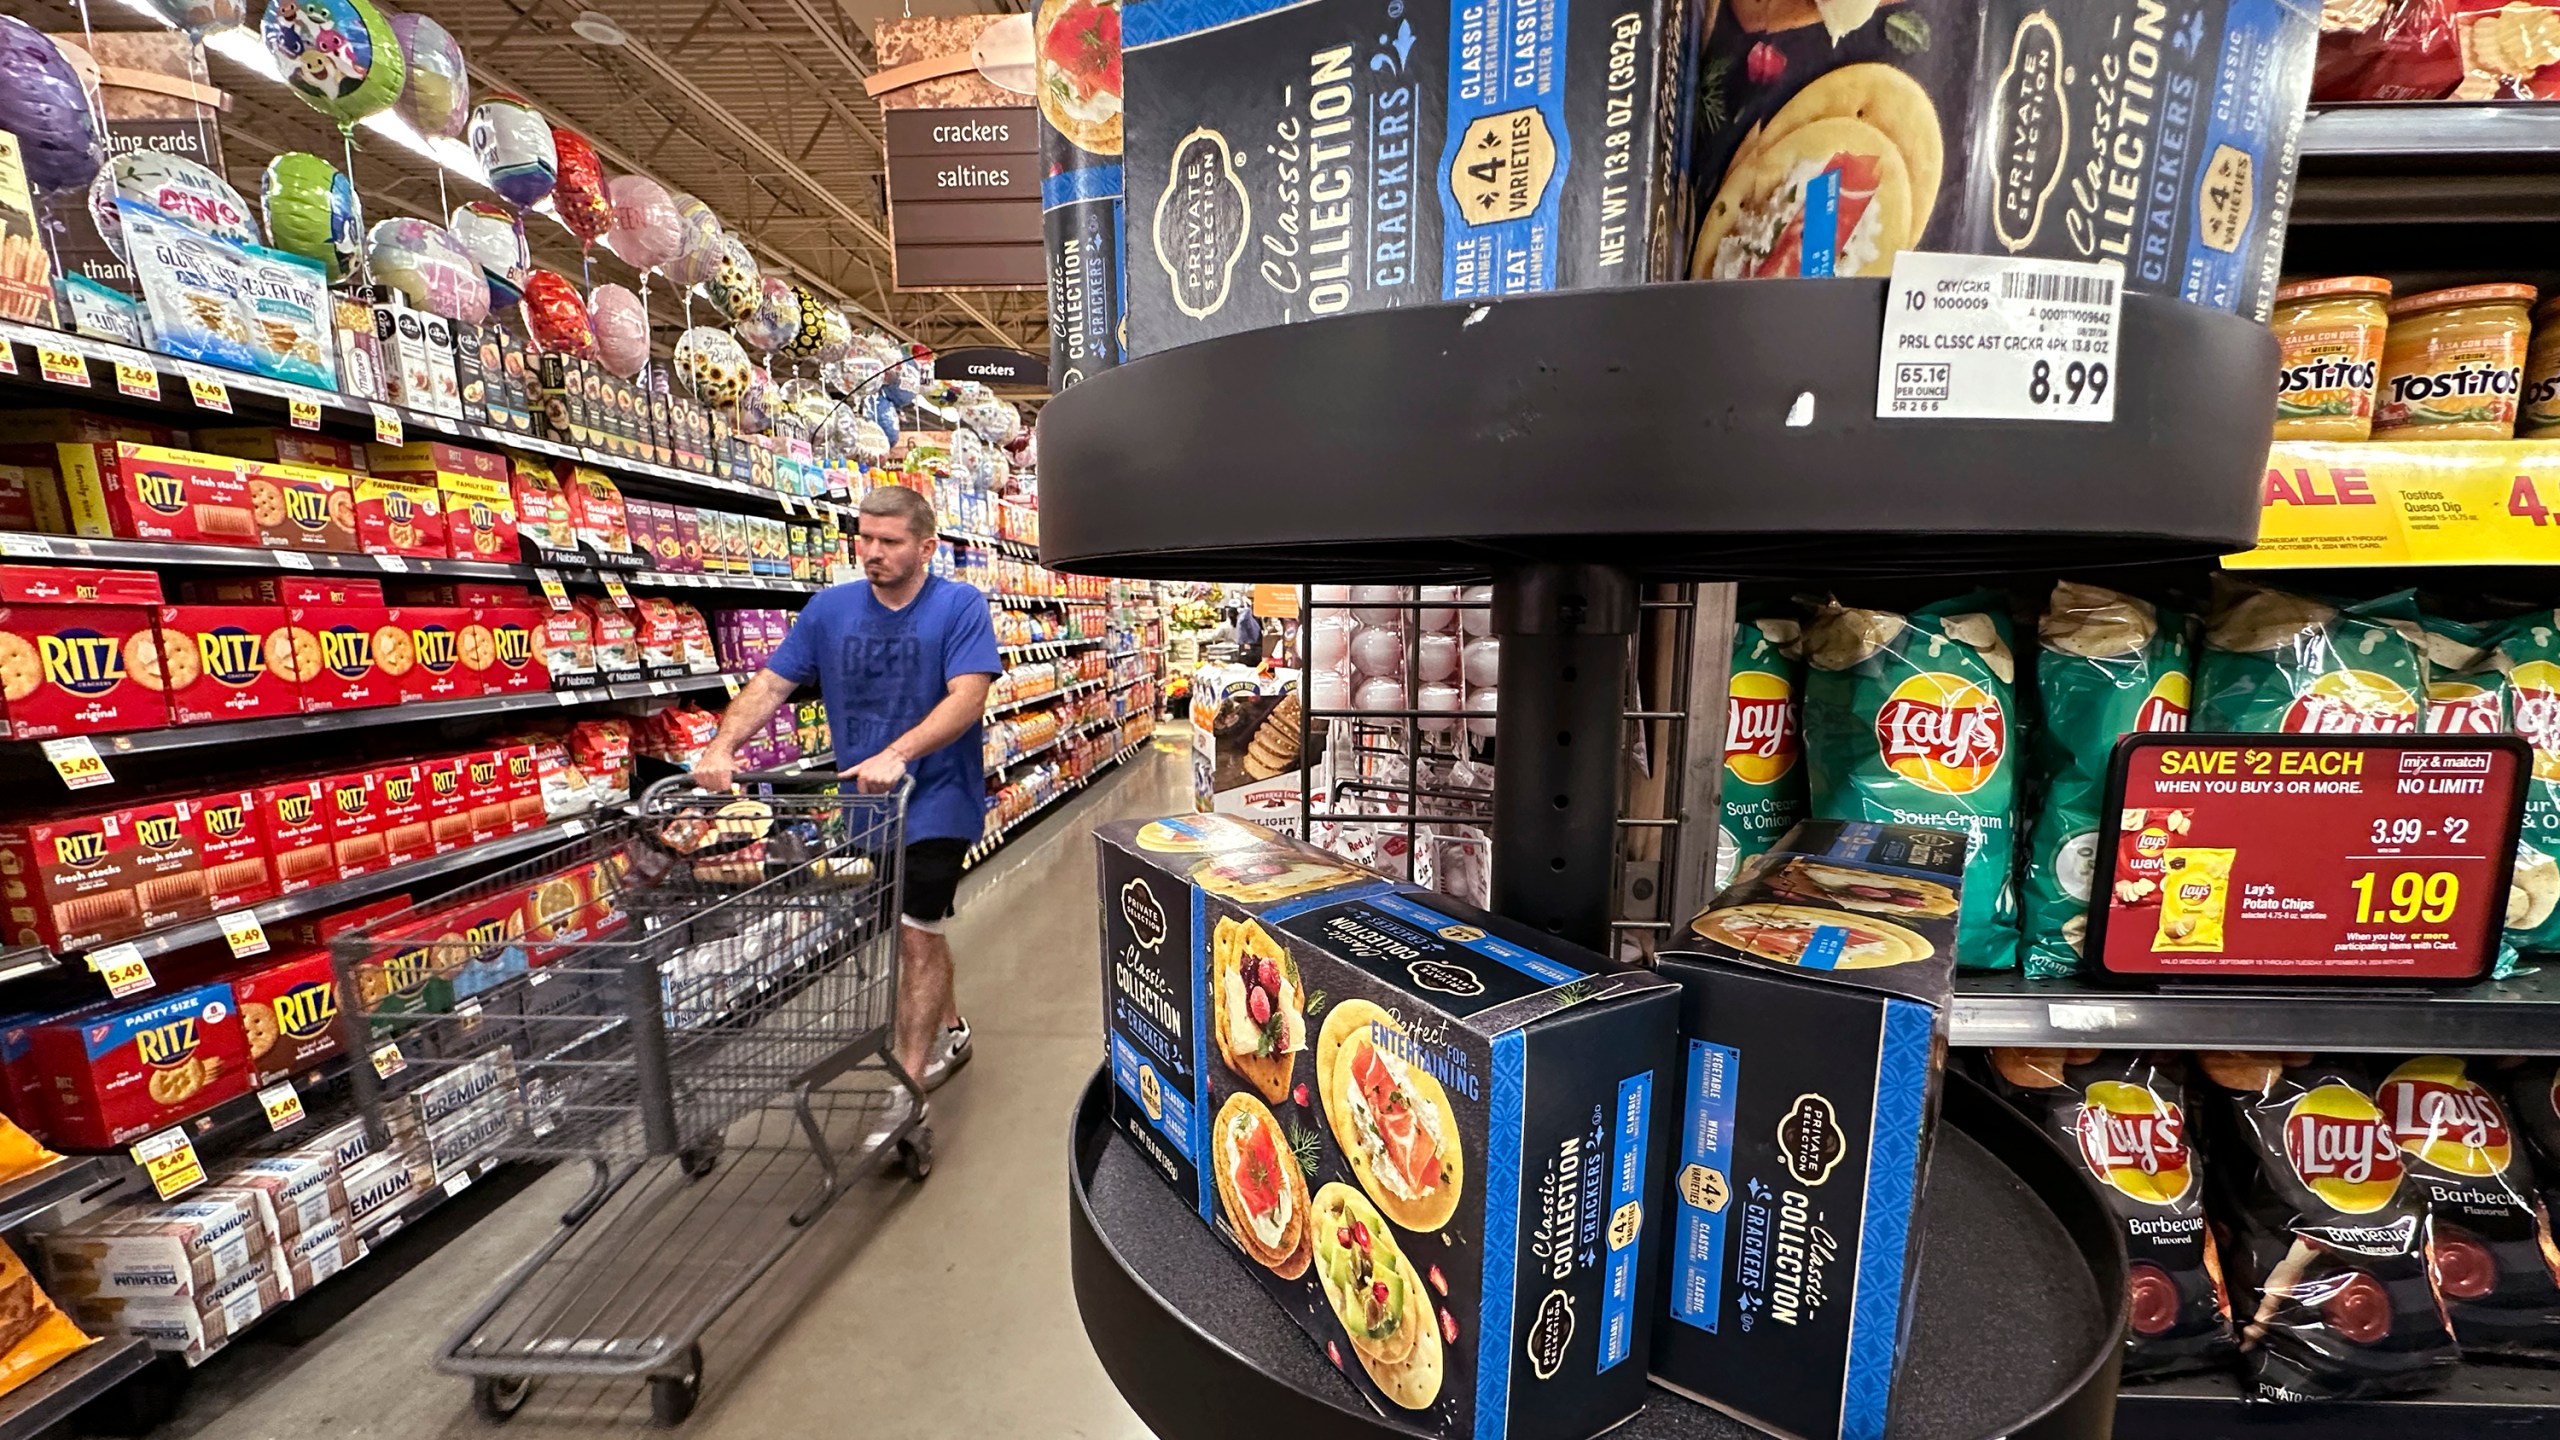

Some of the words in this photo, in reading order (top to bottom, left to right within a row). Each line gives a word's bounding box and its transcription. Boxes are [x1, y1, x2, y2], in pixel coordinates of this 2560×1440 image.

[1461, 6, 1482, 99] CLASSIC
[1608, 12, 1641, 91] (392g)
[1606, 94, 1632, 127] OZ
[933, 120, 1009, 143] crackers
[1510, 116, 1530, 212] VARIETIES
[1605, 133, 1630, 177] 13.8
[937, 165, 1010, 188] saltines
[1376, 87, 1409, 287] CRACKERS
[2142, 75, 2193, 280] CRACKERS
[1261, 117, 1301, 294] Classic
[1603, 186, 1628, 224] WT
[1188, 163, 1202, 289] PRIVATE
[1204, 153, 1215, 290] SELECTION
[1602, 228, 1624, 266] NET
[1064, 239, 1085, 360] COLLECTION
[1090, 258, 1105, 335] CRACKERS
[1905, 290, 1926, 311] 10
[1937, 280, 1990, 294] CKY/CRKR
[1053, 266, 1067, 338] Classic
[1933, 297, 1989, 310] 1000009
[1899, 334, 1931, 350] PRSL
[1934, 335, 1974, 350] CLSSC
[1977, 336, 2000, 350] AST
[2003, 336, 2043, 351] CRCKR
[2046, 338, 2068, 353] 4PK
[2093, 340, 2109, 354] OZ
[46, 352, 79, 368] 2.69
[967, 362, 1015, 377] crackers
[122, 366, 152, 383] 2.69
[194, 380, 223, 397] 4.49
[1900, 367, 1946, 383] 65.1¢
[2029, 359, 2109, 405] 8.99
[1897, 386, 1914, 396] PER
[1915, 386, 1947, 396] OUNCE
[294, 402, 318, 417] 4.49
[1910, 401, 1917, 411] 2
[1920, 401, 1928, 411] 6
[1931, 401, 1939, 411] 6
[191, 475, 216, 489] fresh
[217, 482, 245, 492] stacks
[455, 480, 476, 490] FAMILY
[476, 483, 495, 492] SIZE
[2399, 490, 2444, 500] Tostitos
[2404, 502, 2440, 513] Queso
[2443, 502, 2462, 513] Dip
[556, 552, 587, 565] Nabisco
[619, 555, 644, 567] Nabisco
[197, 633, 267, 675] RITZ
[319, 631, 374, 669] RITZ
[412, 629, 458, 665] RITZ
[493, 628, 532, 660] RITZ
[37, 635, 127, 684] RITZ
[660, 667, 684, 678] Nabisco
[567, 674, 596, 686] Nabisco
[615, 671, 641, 683] Nabisco
[75, 706, 117, 722] original
[225, 696, 259, 710] original
[60, 757, 99, 775] 5.49
[2160, 751, 2239, 775] SAVE
[2244, 749, 2272, 775] $2
[2279, 751, 2364, 775] EACH
[2404, 756, 2429, 772] mix
[2430, 756, 2441, 768] &
[2443, 756, 2485, 768] match
[385, 778, 416, 801] RITZ
[2155, 780, 2201, 793] WHEN
[2204, 781, 2237, 793] YOU
[2240, 781, 2273, 793] BUY
[2274, 781, 2284, 793] 3
[2287, 781, 2310, 793] OR
[2313, 781, 2363, 793] MORE.
[2397, 779, 2424, 793] NO
[2428, 779, 2484, 794] LIMIT!
[204, 806, 245, 834] RITZ
[278, 828, 300, 839] fresh
[300, 823, 323, 835] stacks
[1743, 817, 1753, 830] &
[1755, 813, 1792, 828] Onion
[1893, 809, 1942, 826] Sour
[1946, 809, 2002, 830] Cream
[2371, 818, 2422, 844] 3.99
[2443, 816, 2469, 844] $2
[54, 832, 109, 864] RITZ
[136, 853, 165, 866] fresh
[165, 847, 193, 861] stacks
[204, 841, 228, 853] fresh
[229, 836, 255, 848] stacks
[54, 873, 87, 886] fresh
[88, 865, 121, 879] stacks
[2245, 883, 2275, 895] Lay's
[1127, 895, 1159, 922] PRIVATE
[2242, 898, 2279, 909] Potato
[2281, 898, 2315, 911] Chips
[2351, 871, 2459, 924] 1.99
[230, 929, 260, 945] 5.49
[1327, 916, 1421, 960] COLLECTION
[2334, 942, 2387, 952] participating
[2389, 942, 2412, 950] items
[2413, 942, 2432, 950] with
[2433, 942, 2458, 950] Card.
[2347, 932, 2372, 940] When
[2372, 933, 2388, 942] you
[2390, 932, 2406, 942] buy
[108, 964, 143, 984] 5.49
[125, 1006, 169, 1028] PARTY
[170, 997, 200, 1017] SIZE
[1116, 962, 1181, 1038] COLLECTION
[1386, 1006, 1450, 1047] Perfect
[135, 1017, 201, 1065] RITZ
[1370, 1020, 1480, 1103] ENTERTAINING
[1447, 1045, 1468, 1069] FOR
[106, 1072, 143, 1091] original
[1710, 1052, 1723, 1100] VEGETABLE
[270, 1098, 297, 1118] 5.49
[425, 1070, 498, 1119] PREMIUM
[1626, 1092, 1637, 1135] CLASSIC
[2395, 1081, 2500, 1148] Lay's
[1706, 1119, 1717, 1153] WHEAT
[1798, 1105, 1812, 1172] SELECTION
[1807, 1109, 1823, 1172] PRIVATE
[2090, 1105, 2180, 1175] Lay's
[2301, 1115, 2397, 1184] Lay's
[158, 1153, 186, 1170] 5.49
[280, 1165, 334, 1202] PREMIUM
[1690, 1166, 1702, 1206] VARIETIES
[1531, 1167, 1556, 1258] Classic
[1553, 1136, 1582, 1280] COLLECTION
[1583, 1153, 1601, 1245] CRACKERS
[2463, 1206, 2510, 1217] Flavored
[195, 1208, 252, 1250] PREMIUM
[294, 1220, 346, 1258] PREMIUM
[2129, 1217, 2204, 1236] Barbecue
[2152, 1235, 2192, 1246] Flavored
[2326, 1226, 2409, 1242] Barbecue
[1698, 1222, 1711, 1262] CLASSIC
[1741, 1203, 1765, 1289] CRACKERS
[2359, 1244, 2398, 1255] Flavored
[1771, 1190, 1809, 1326] COLLECTION
[205, 1262, 265, 1305] PREMIUM
[1694, 1275, 1706, 1314] CLASSIC
[1543, 1306, 1555, 1366] PRIVATE
[1550, 1300, 1562, 1365] SELECTION
[1607, 1315, 1619, 1363] VEGETABLE
